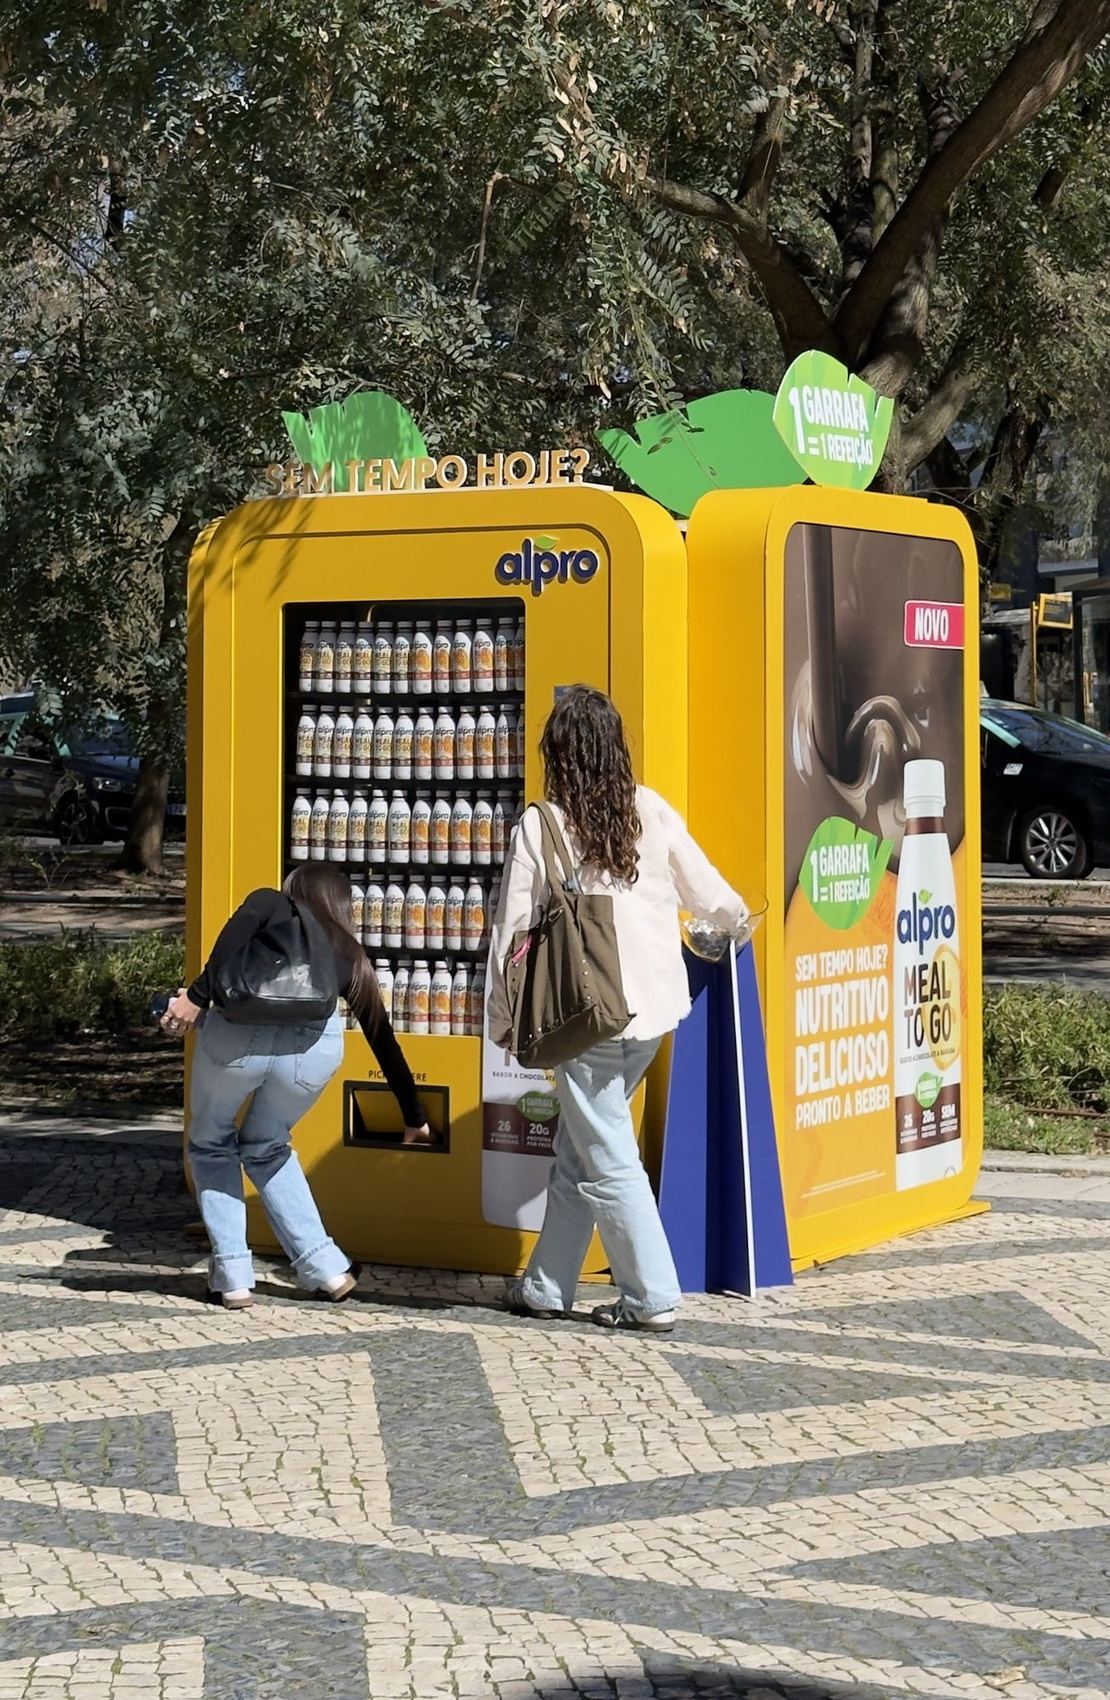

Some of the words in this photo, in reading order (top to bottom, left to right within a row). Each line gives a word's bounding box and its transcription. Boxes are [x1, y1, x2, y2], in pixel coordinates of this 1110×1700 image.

[788, 386, 805, 454] 1
[802, 385, 869, 432] GARRAFA
[264, 461, 335, 495] SEM
[345, 454, 468, 493] TEMPO
[477, 447, 590, 490] HOJE?
[820, 432, 827, 460] 1
[827, 433, 873, 471] REFEIÇÃO
[495, 537, 599, 597] alpro
[915, 608, 949, 642] NOVO
[810, 849, 819, 903] 1
[820, 843, 870, 877] GARRAFA
[829, 881, 834, 903] 1
[834, 874, 870, 906] REFEIÇÃO
[897, 891, 955, 956] alpro
[795, 953, 817, 982] SEM
[819, 947, 854, 978] TEMPO
[856, 943, 888, 973] HOJE?
[904, 960, 951, 1006] MEAL
[795, 974, 889, 1038] NUTRITIVO
[904, 1005, 925, 1049] TO
[930, 1002, 951, 1045] GO
[368, 1070, 385, 1079] PIC
[411, 1072, 427, 1082] ERE
[795, 1029, 889, 1097] DELICIOSO
[497, 1120, 511, 1132] 26
[529, 1123, 550, 1136] 20G
[795, 1094, 841, 1131] PRONTO
[843, 1091, 853, 1119] A
[855, 1083, 890, 1116] BEBER
